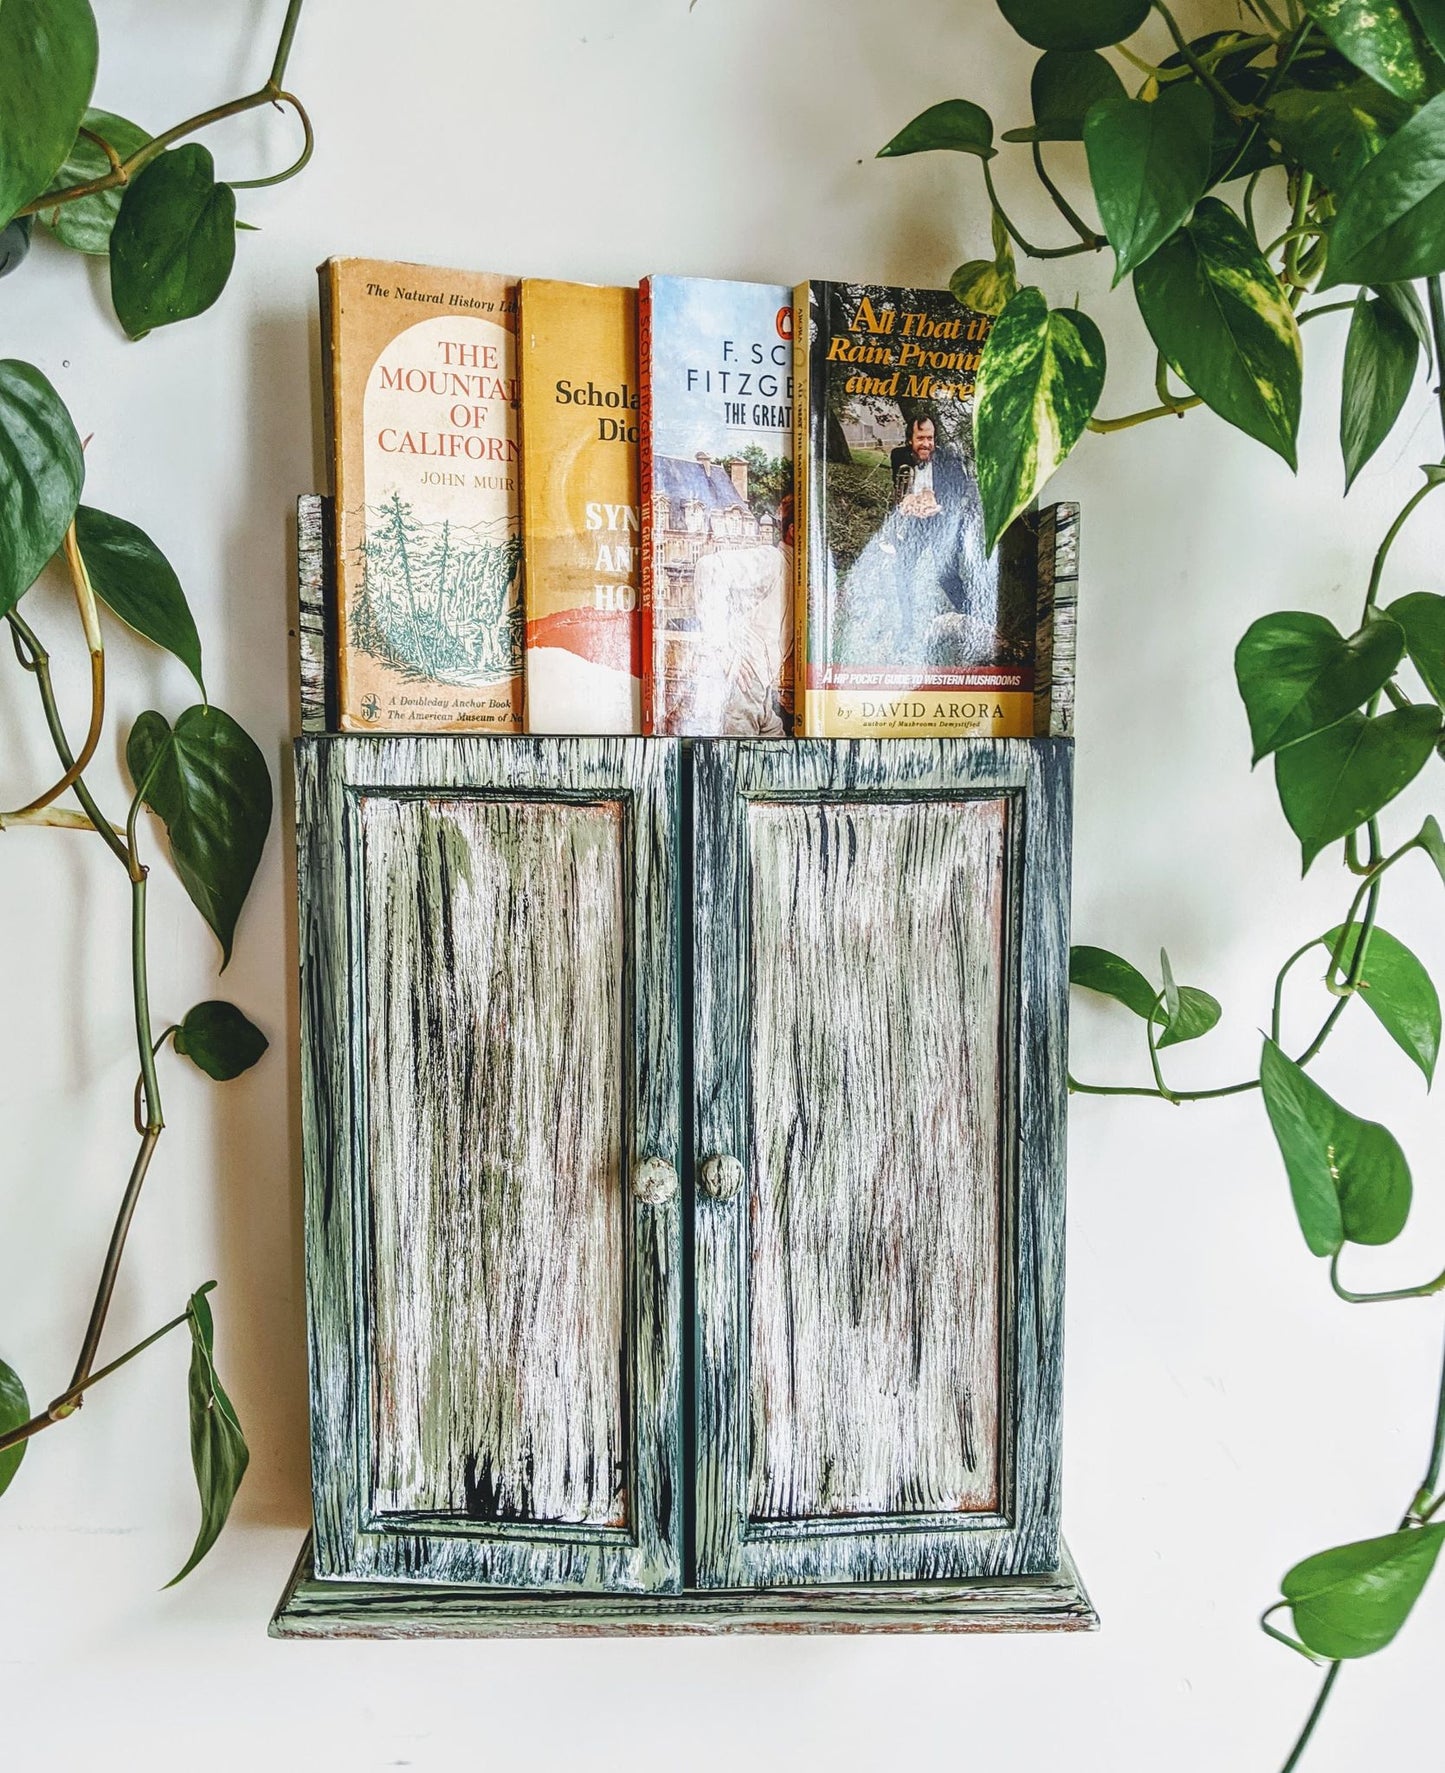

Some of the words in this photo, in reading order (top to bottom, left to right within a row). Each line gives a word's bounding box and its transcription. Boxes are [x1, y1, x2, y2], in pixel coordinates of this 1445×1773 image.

[367, 283, 390, 297] The
[394, 287, 444, 305] Natural
[448, 294, 495, 312] History
[850, 297, 896, 334] All
[901, 312, 962, 340] That
[438, 341, 499, 370] THE
[640, 315, 650, 374] SCOTT
[723, 341, 738, 362] F.
[826, 337, 890, 365] Rain
[845, 373, 900, 397] and
[902, 374, 975, 402] More
[450, 403, 488, 429] OF
[724, 402, 746, 425] THE
[752, 404, 793, 428] GREAT
[640, 384, 651, 494] FITZGERALD
[420, 471, 465, 487] JOHN
[474, 475, 515, 491] MUIR
[586, 502, 640, 532] SYN
[642, 501, 650, 521] THE
[642, 526, 651, 561] GREAT
[594, 584, 642, 612] HO
[642, 566, 651, 607] GATSBY
[822, 667, 833, 684] A
[834, 673, 850, 684] HIP
[850, 673, 885, 685] POCKET
[885, 673, 913, 685] GUIDE
[912, 673, 923, 685] TO
[924, 674, 965, 686] WESTERN
[965, 675, 1021, 686] MUSHROOMS
[388, 697, 396, 706] A
[400, 697, 449, 708] Doubleday
[452, 699, 486, 708] Anchor
[489, 699, 512, 708] Book
[388, 710, 405, 720] The
[408, 711, 453, 721] American
[456, 712, 495, 722] Museum
[497, 713, 508, 722] of
[837, 706, 853, 719] by
[862, 702, 926, 718] DAVID
[933, 703, 1005, 718] ARORA
[888, 720, 897, 728] of
[939, 720, 981, 729] Demystified
